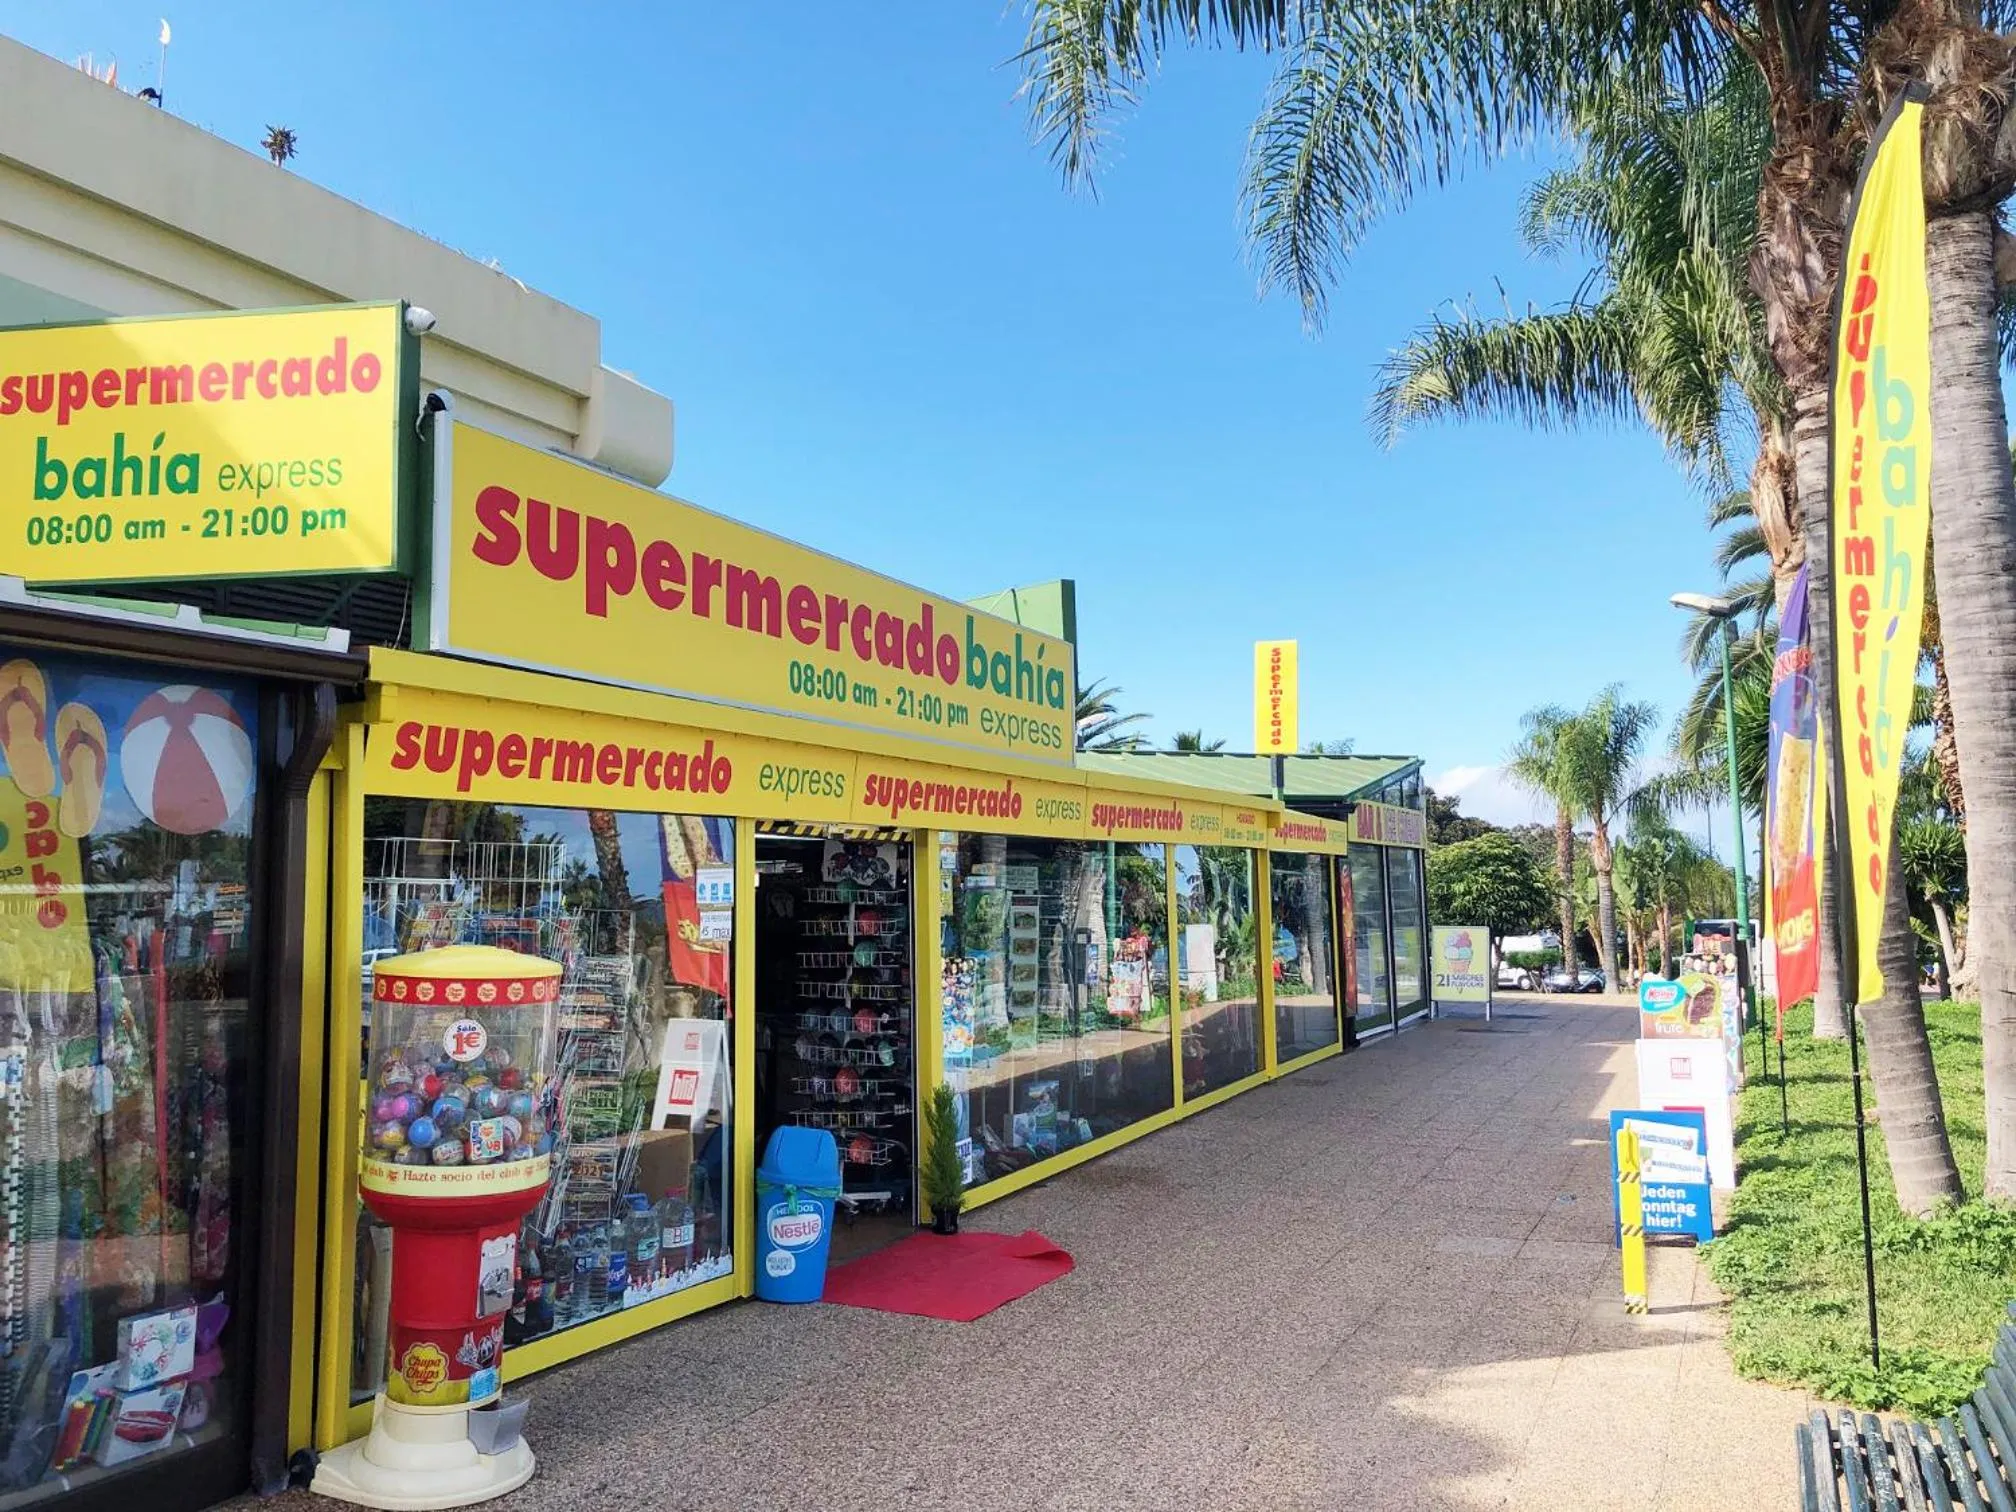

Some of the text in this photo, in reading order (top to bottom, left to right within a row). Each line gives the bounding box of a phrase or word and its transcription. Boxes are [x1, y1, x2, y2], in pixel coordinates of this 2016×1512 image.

[0, 336, 382, 426] supermercado
[33, 431, 343, 501] bahía express
[27, 514, 112, 546] 08:00
[125, 516, 165, 541] am
[201, 504, 289, 539] 21:00
[301, 506, 347, 536] pm
[472, 485, 1065, 710] supermercado bahía
[788, 660, 847, 702] 08:00
[852, 681, 878, 708] am
[896, 686, 943, 727] 21:00
[947, 703, 969, 728] pm
[1269, 647, 1283, 746] supermercado
[980, 707, 1063, 751] express
[390, 720, 846, 802] supermercado express
[863, 773, 1082, 825] supermercado express
[1091, 800, 1221, 836] supermercado express
[403, 1170, 436, 1182] Hazte
[441, 1172, 473, 1182] socio
[477, 1170, 495, 1181] del
[1641, 1184, 1687, 1199] Jeden
[1641, 1200, 1698, 1217] onntag
[1645, 1213, 1683, 1229] hier!
[406, 1366, 439, 1382] Chups
[408, 1355, 442, 1370] Chupa
